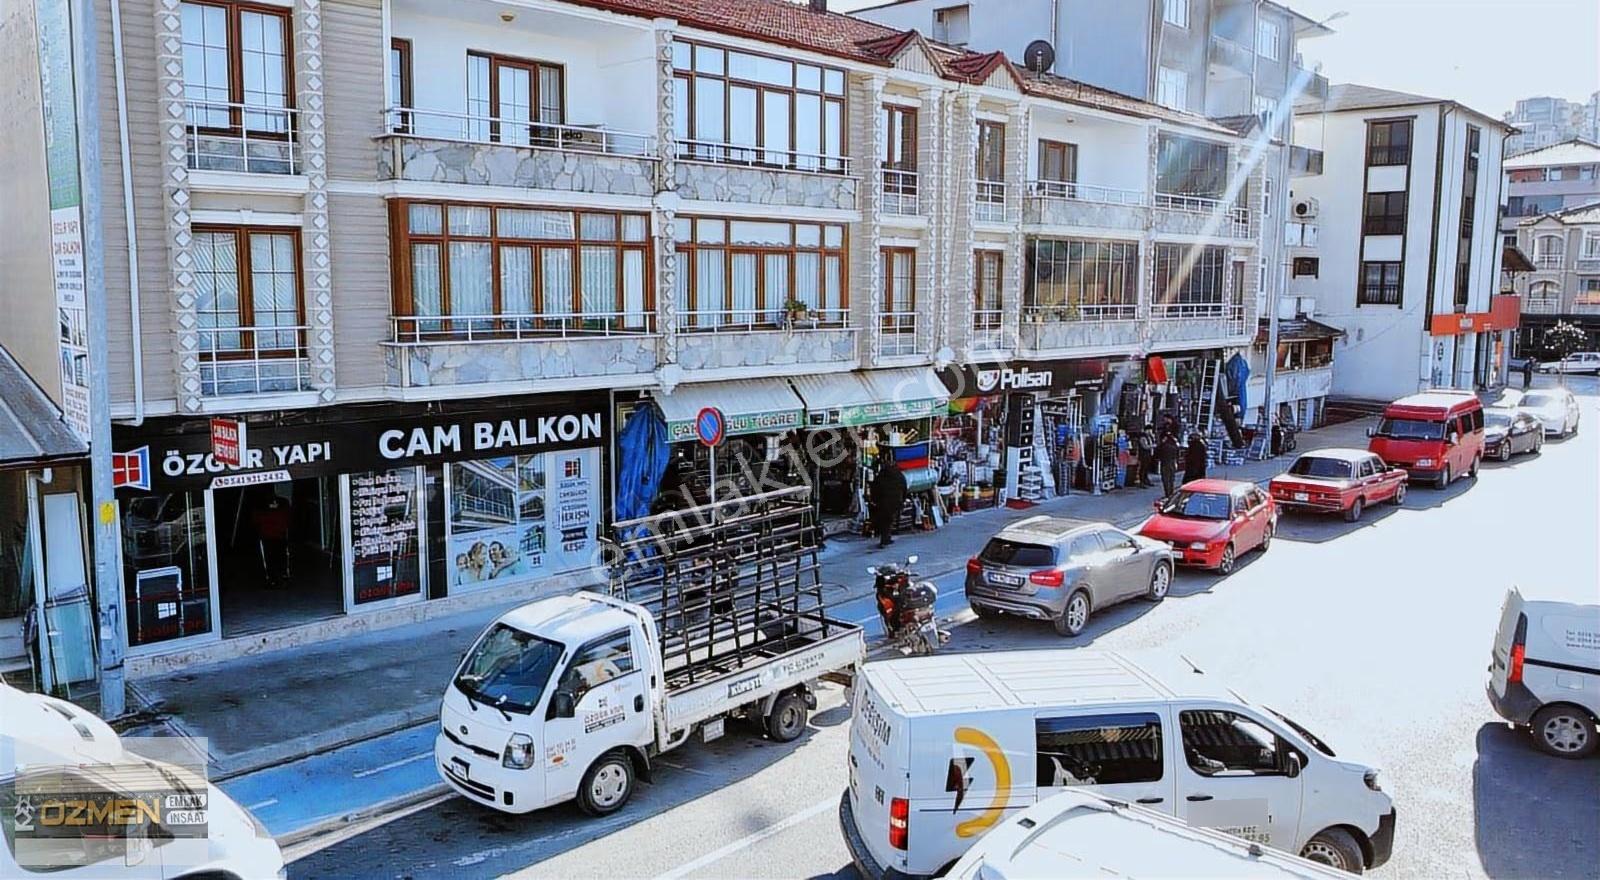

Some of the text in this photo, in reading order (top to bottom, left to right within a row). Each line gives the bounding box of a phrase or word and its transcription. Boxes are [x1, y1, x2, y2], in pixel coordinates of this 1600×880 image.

[1001, 367, 1052, 390] Polisan
[379, 413, 601, 459] CAM BALKON
[162, 450, 264, 476] ÖZGR
[272, 441, 331, 466] YAPI
